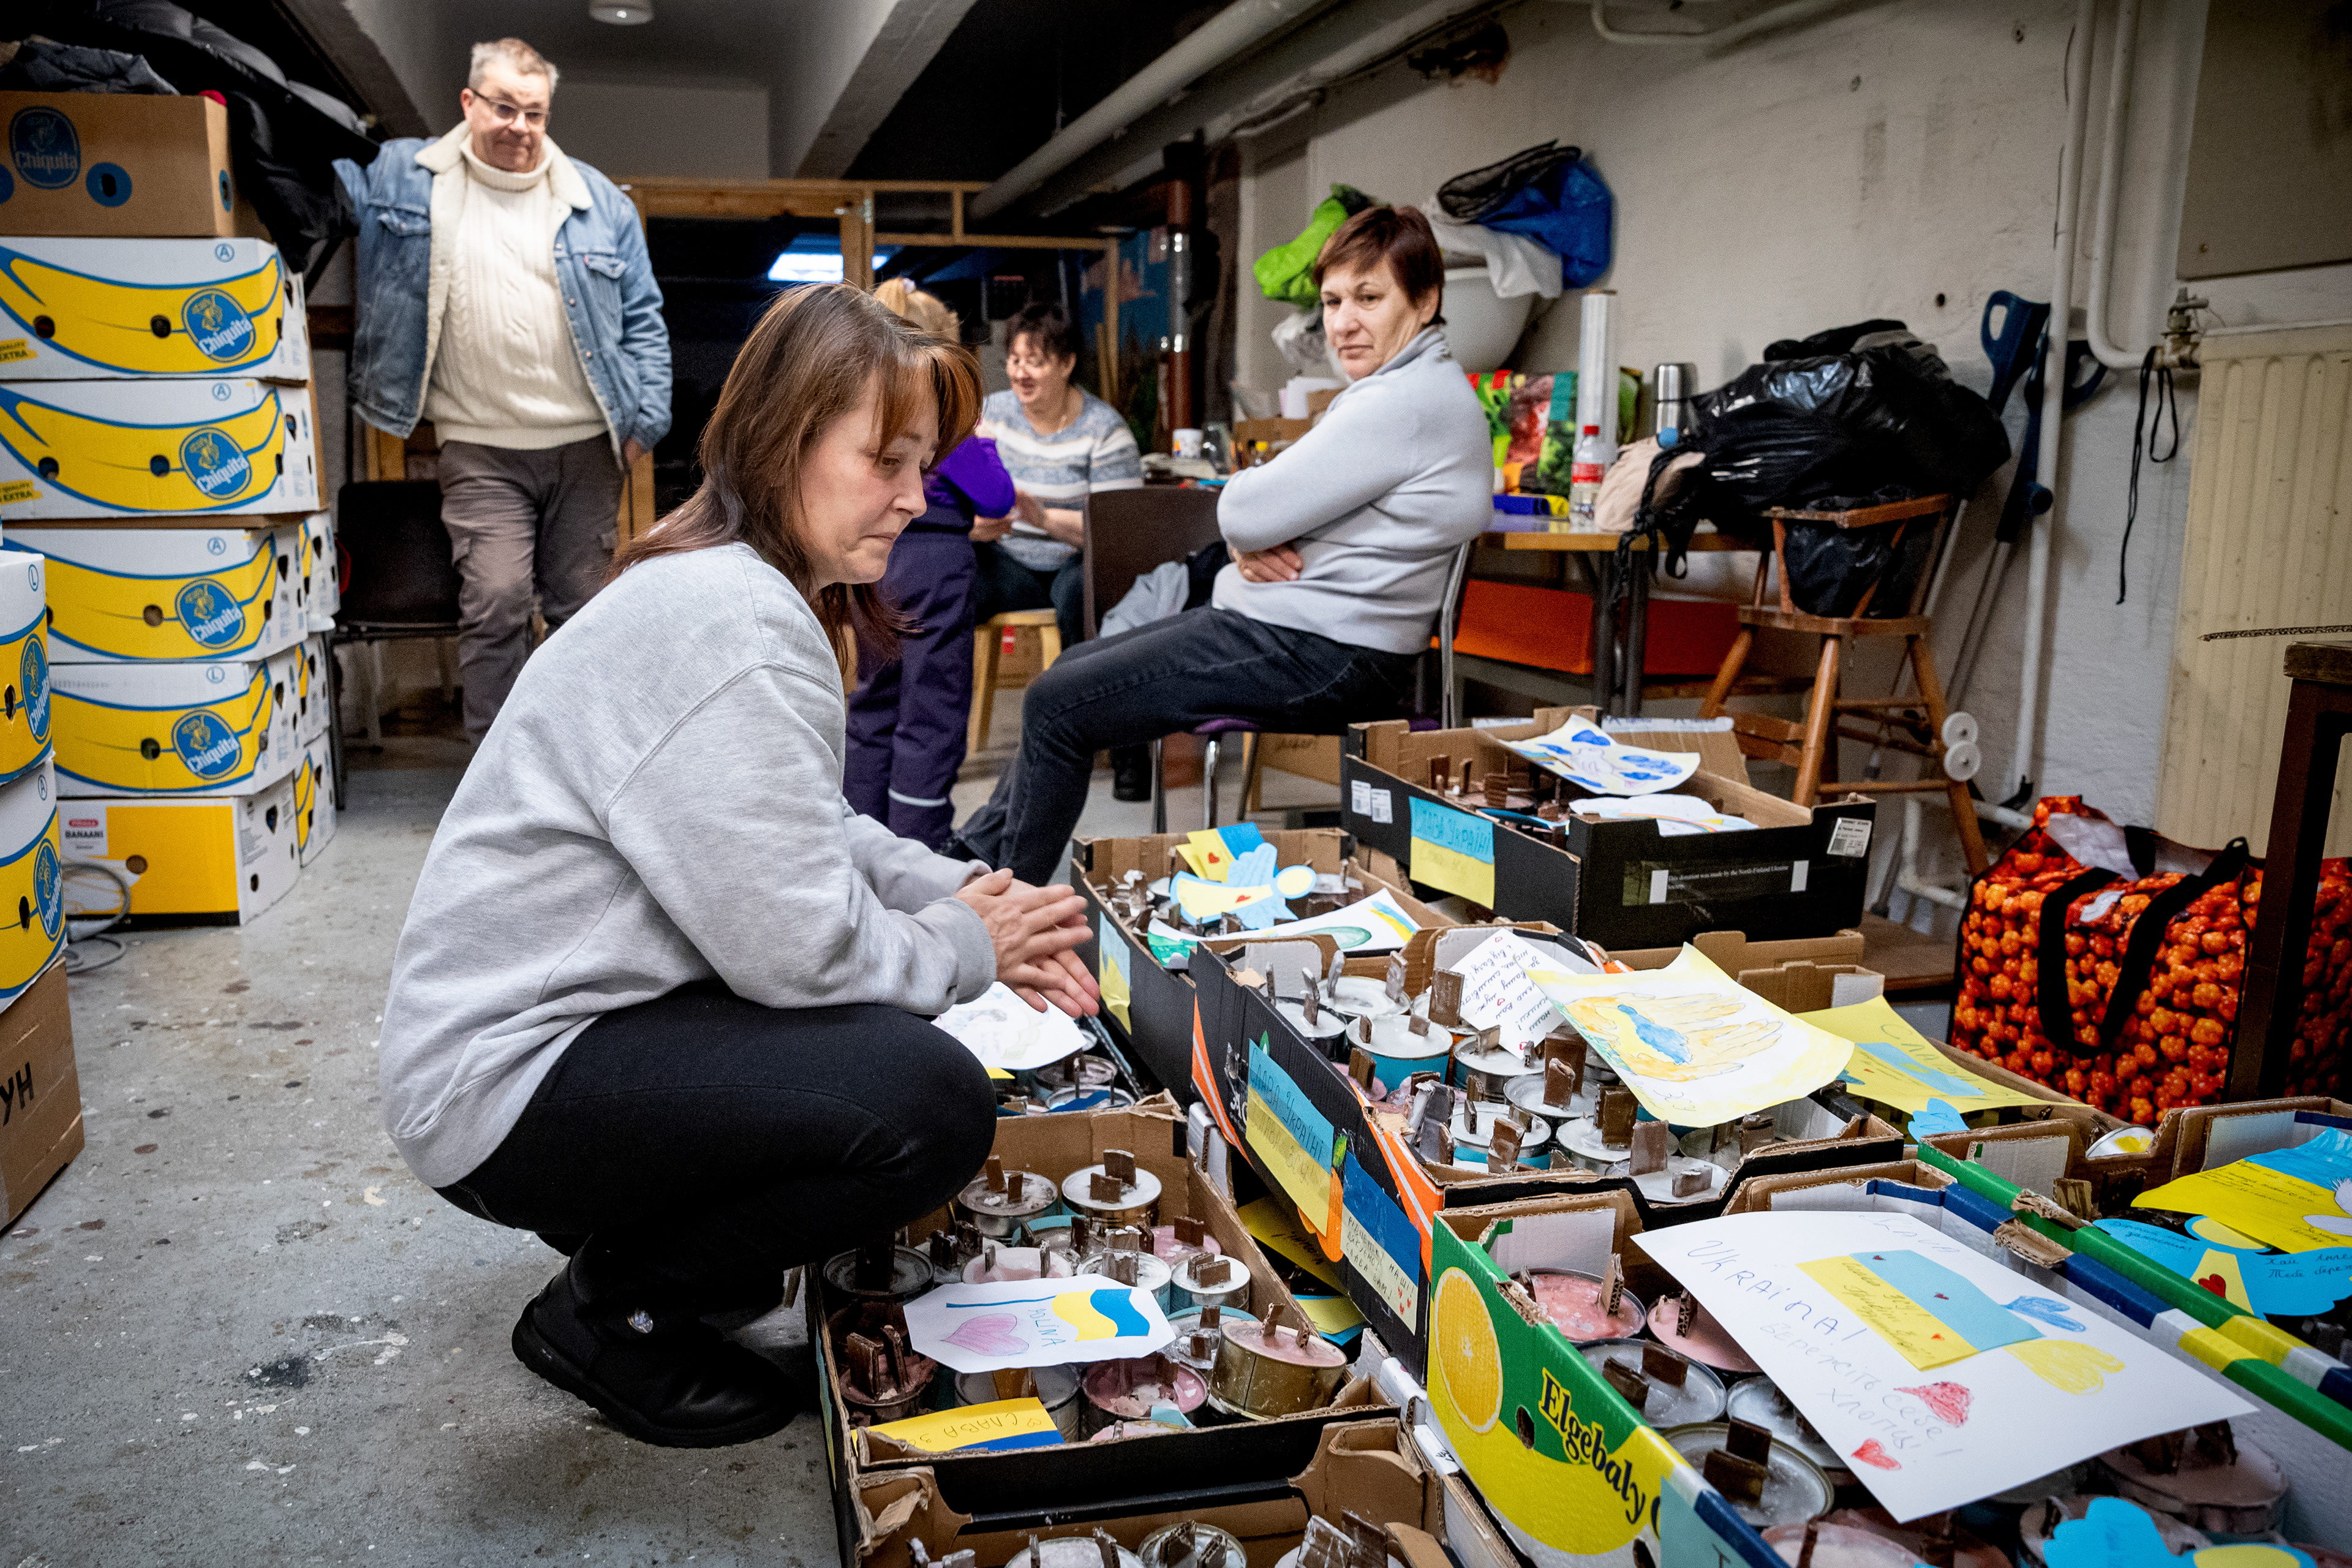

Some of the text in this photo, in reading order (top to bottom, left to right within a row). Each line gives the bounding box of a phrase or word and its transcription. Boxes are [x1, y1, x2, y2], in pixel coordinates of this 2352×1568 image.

[15, 151, 78, 175] Chiquita
[198, 315, 253, 356] Chiquita
[197, 454, 249, 493] Chiquita
[189, 605, 240, 643] Chiquita
[187, 737, 239, 774] Chiquita
[65, 830, 104, 839] BANAANI
[944, 1412, 1018, 1438] СЛАВА
[1540, 1373, 1646, 1525] Elgebaly
